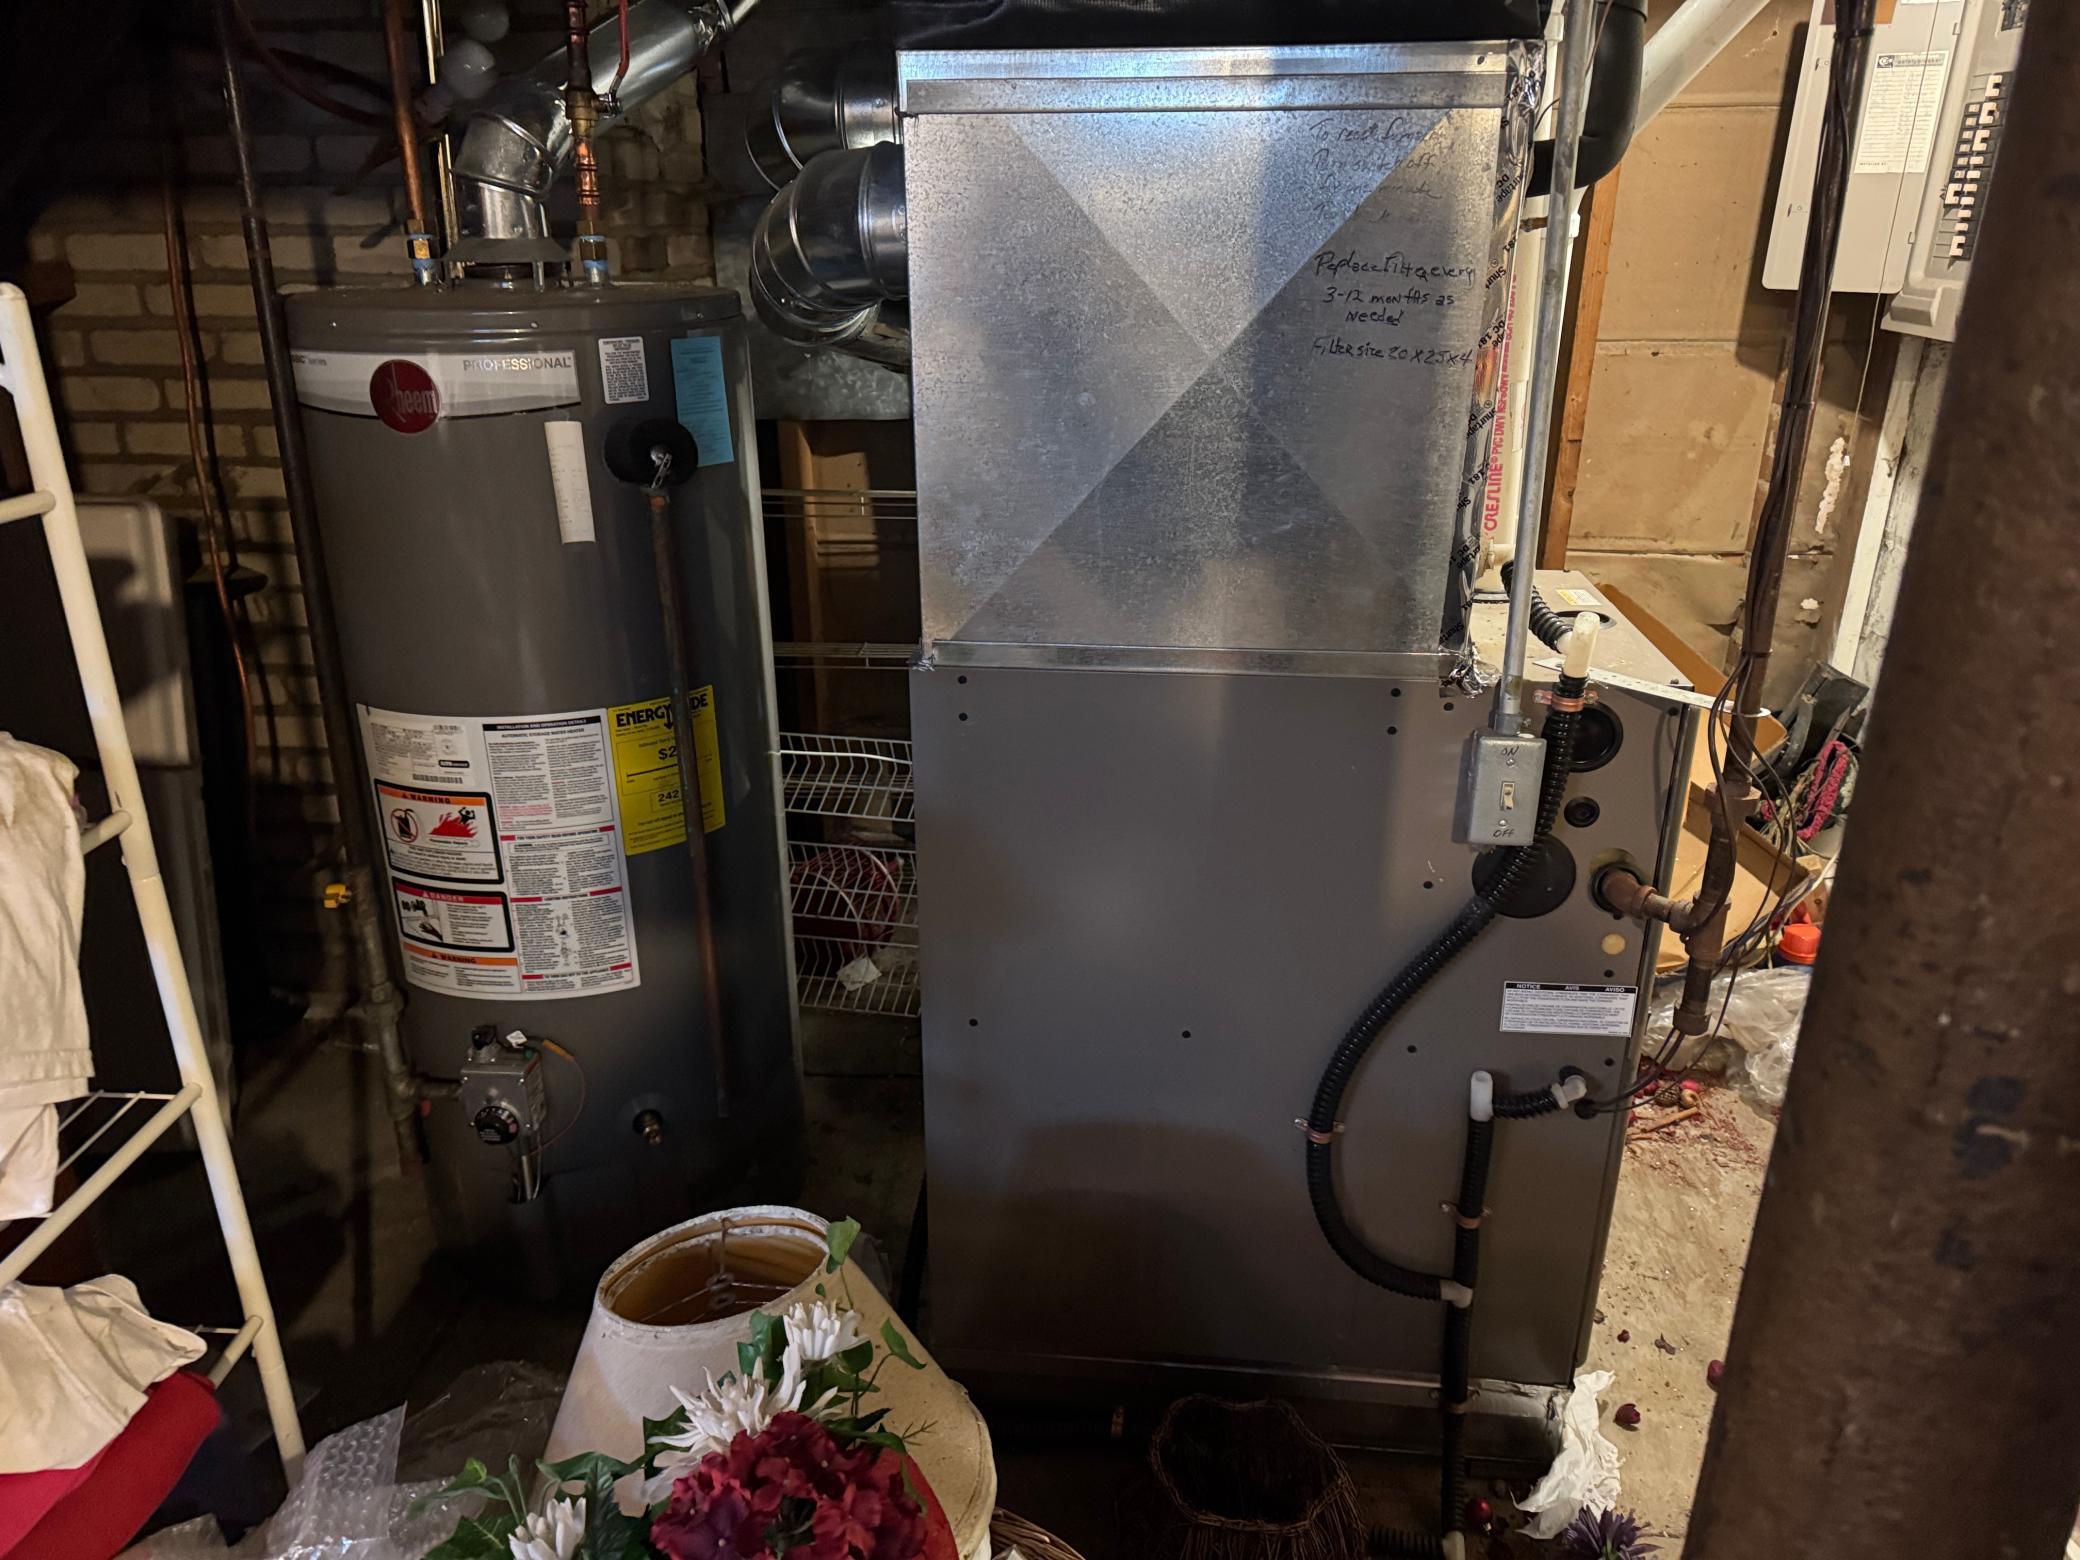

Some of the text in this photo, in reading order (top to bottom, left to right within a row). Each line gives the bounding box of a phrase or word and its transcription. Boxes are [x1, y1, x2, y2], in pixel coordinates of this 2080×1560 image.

[463, 356, 572, 371] PROFESSIONAL
[1501, 745, 1519, 757] ON
[410, 794, 451, 804] WARNING
